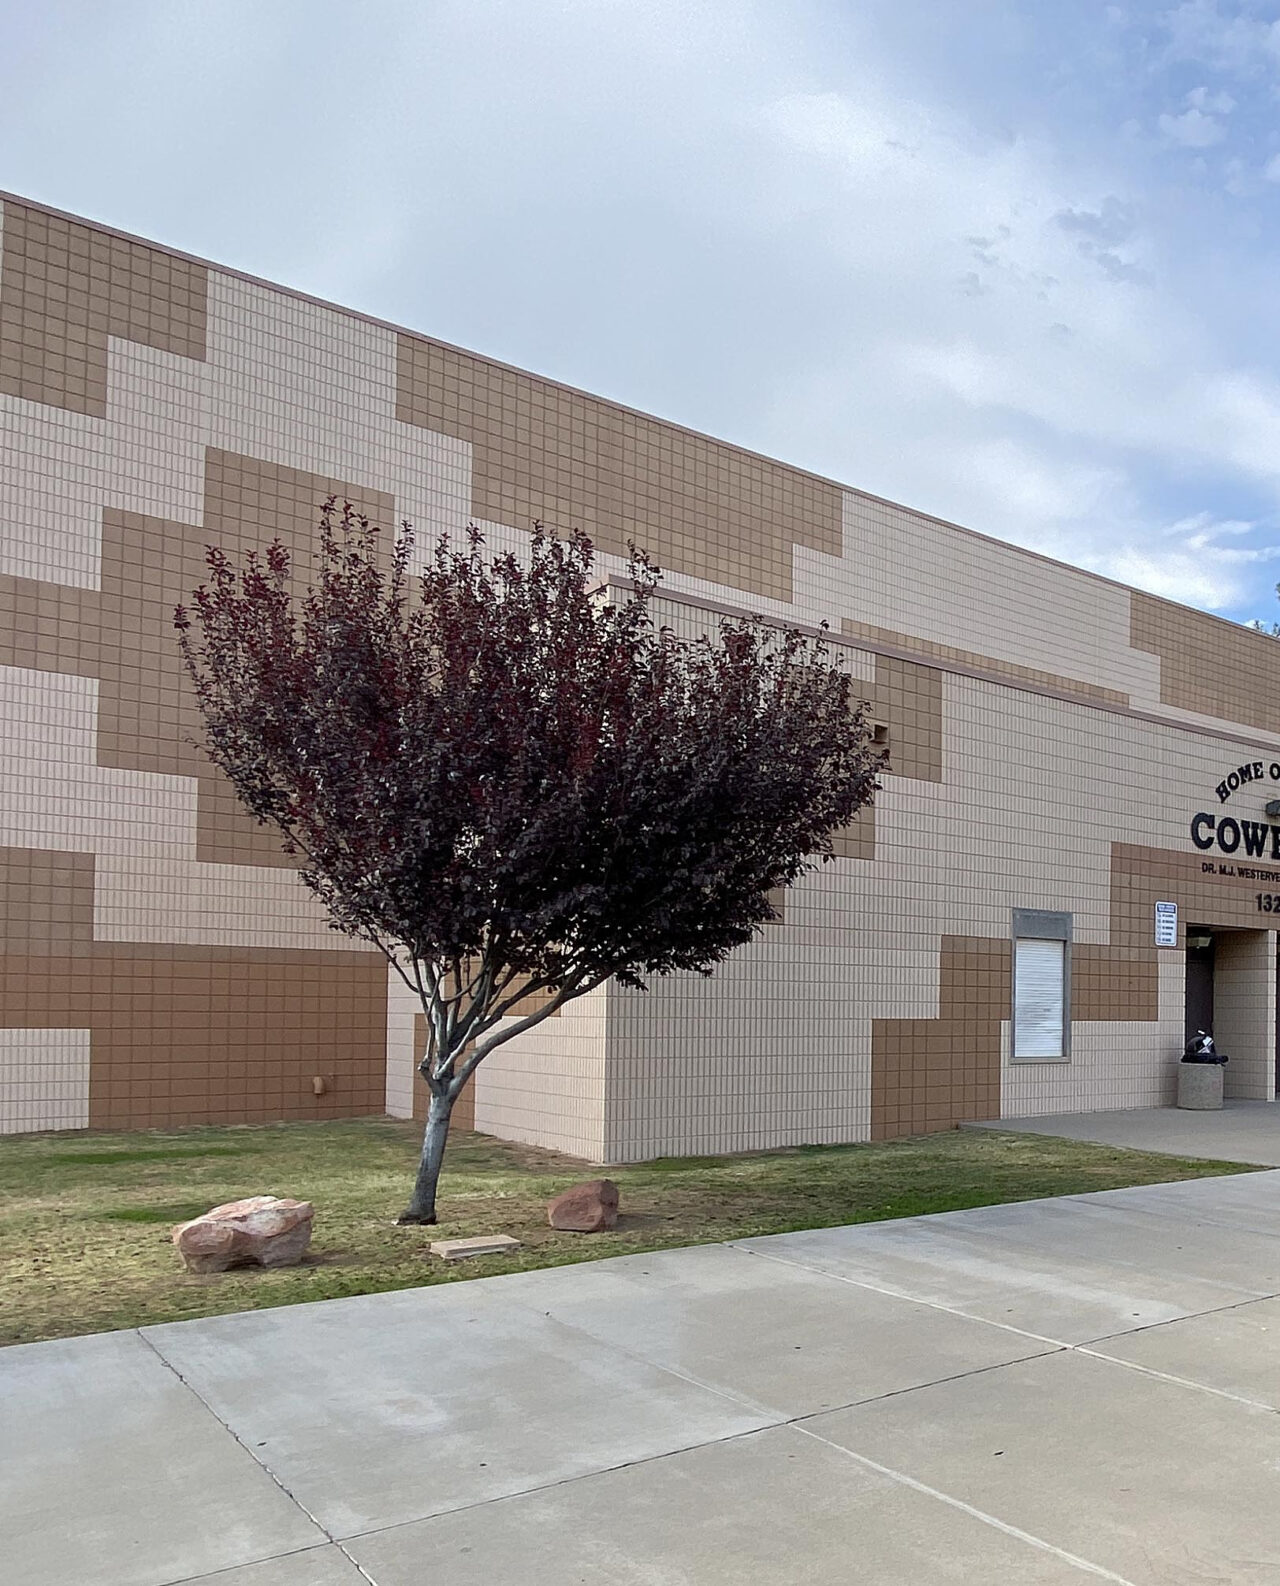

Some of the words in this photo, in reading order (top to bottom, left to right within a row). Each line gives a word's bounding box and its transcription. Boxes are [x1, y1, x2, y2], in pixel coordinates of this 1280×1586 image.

[1215, 761, 1264, 803] HOME
[1201, 862, 1217, 874] DR.
[1219, 865, 1236, 877] M.J.
